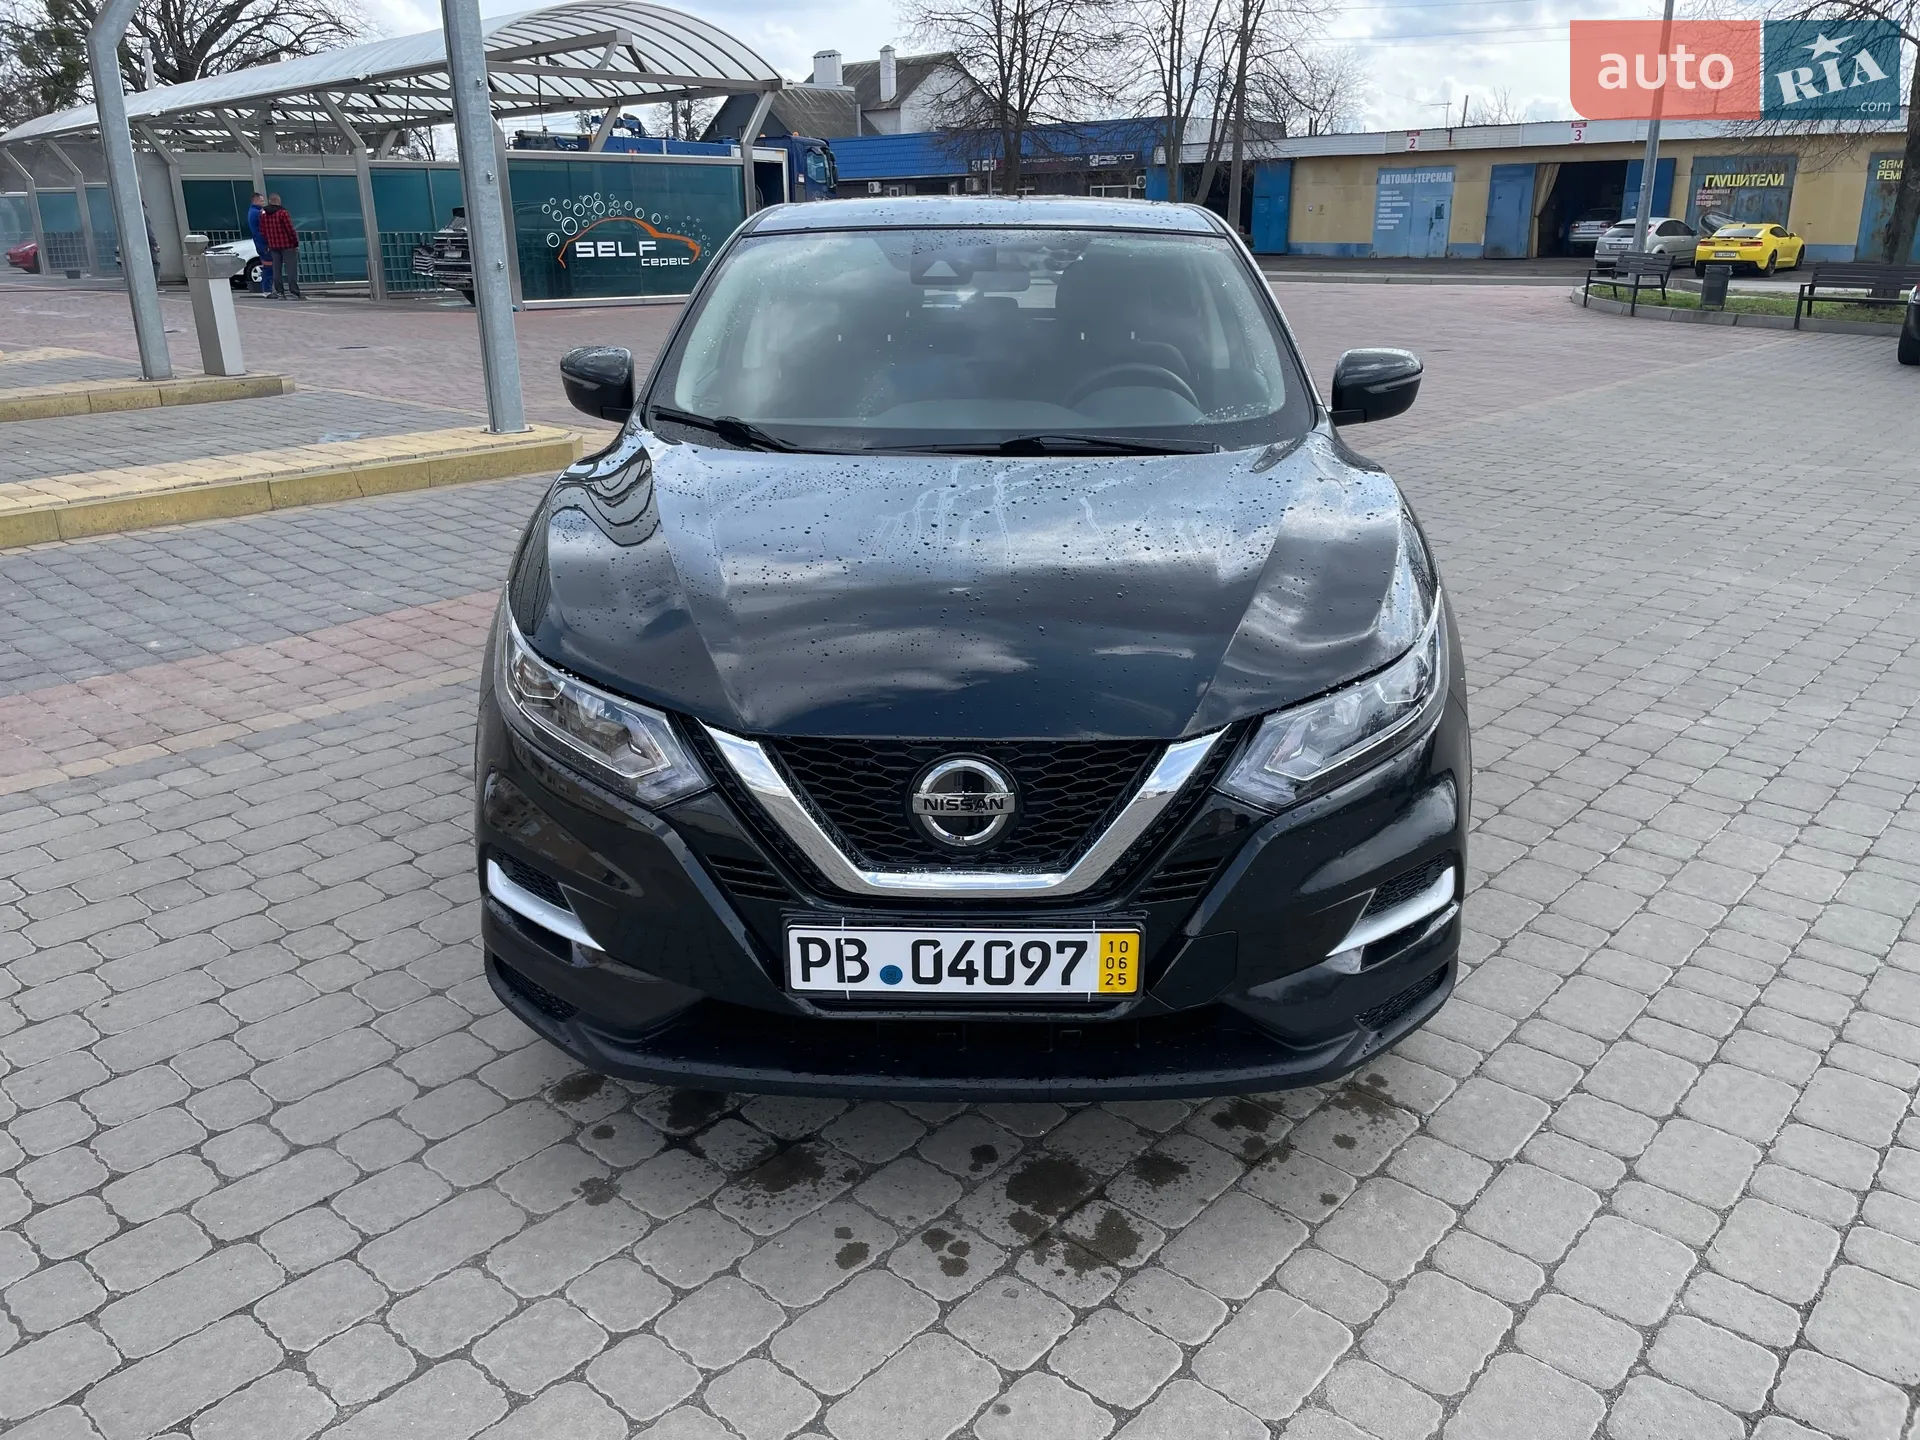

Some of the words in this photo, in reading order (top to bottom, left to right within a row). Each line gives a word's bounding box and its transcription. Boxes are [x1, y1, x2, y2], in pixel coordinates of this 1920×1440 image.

[1574, 129, 1582, 141] 3
[1409, 138, 1416, 149] 2
[1878, 159, 1904, 169] ЗАМ
[1380, 172, 1452, 184] АВТОМАСТЕРСКАЯ
[1704, 173, 1785, 188] ГЛУШИТЕЛИ
[1876, 170, 1902, 180] РЕМ
[575, 241, 657, 258] SELF
[923, 798, 1004, 811] NISSAN
[1108, 941, 1129, 954] 10
[797, 937, 870, 984] PB
[911, 939, 1088, 986] 04097
[1105, 957, 1128, 969] 06
[1105, 973, 1128, 986] 25
